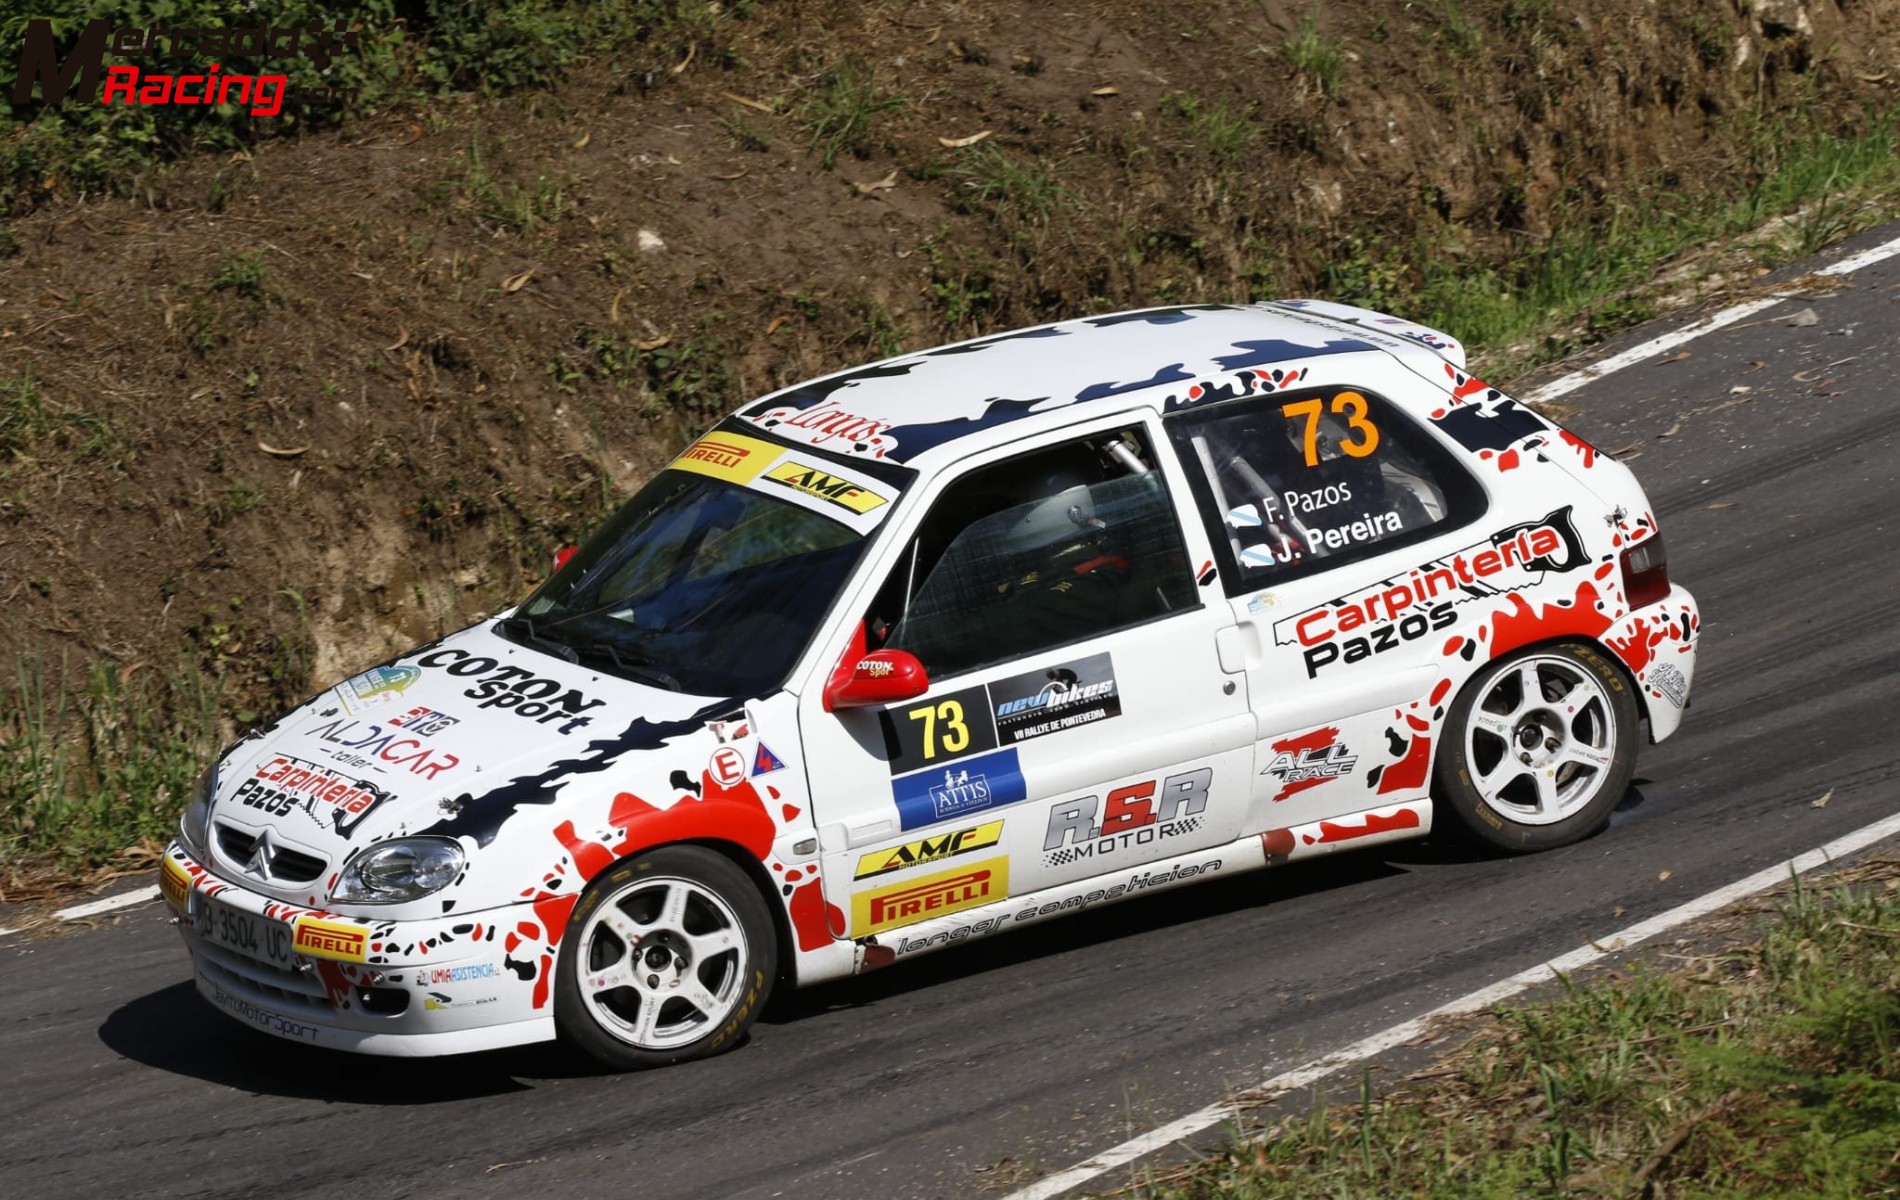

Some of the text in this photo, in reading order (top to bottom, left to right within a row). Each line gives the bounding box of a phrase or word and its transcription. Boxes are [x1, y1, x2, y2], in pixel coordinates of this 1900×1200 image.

[1282, 391, 1379, 467] 73
[783, 470, 865, 499] AMF
[1263, 482, 1352, 523] F. Pazos
[1277, 510, 1403, 563] J. Pereira
[1296, 529, 1559, 647] Carpintería
[1303, 601, 1458, 679] Pazos
[417, 649, 606, 714] COTON
[909, 700, 970, 759] 73
[1024, 721, 1050, 738] RALLYE
[1050, 719, 1061, 730] DE
[1060, 708, 1107, 728] PONTEVEDRA
[304, 718, 460, 781] ALDACAR
[329, 750, 373, 770] taller
[715, 751, 740, 781] E
[1260, 743, 1359, 775] ALL
[1283, 762, 1356, 783] RACE
[230, 777, 303, 818] Pazos
[939, 781, 987, 808] ATTIS
[881, 828, 977, 868] AMF
[1074, 822, 1175, 861] MOTOR
[870, 869, 992, 926] PIRELLI
[297, 924, 364, 956] PIRELLI
